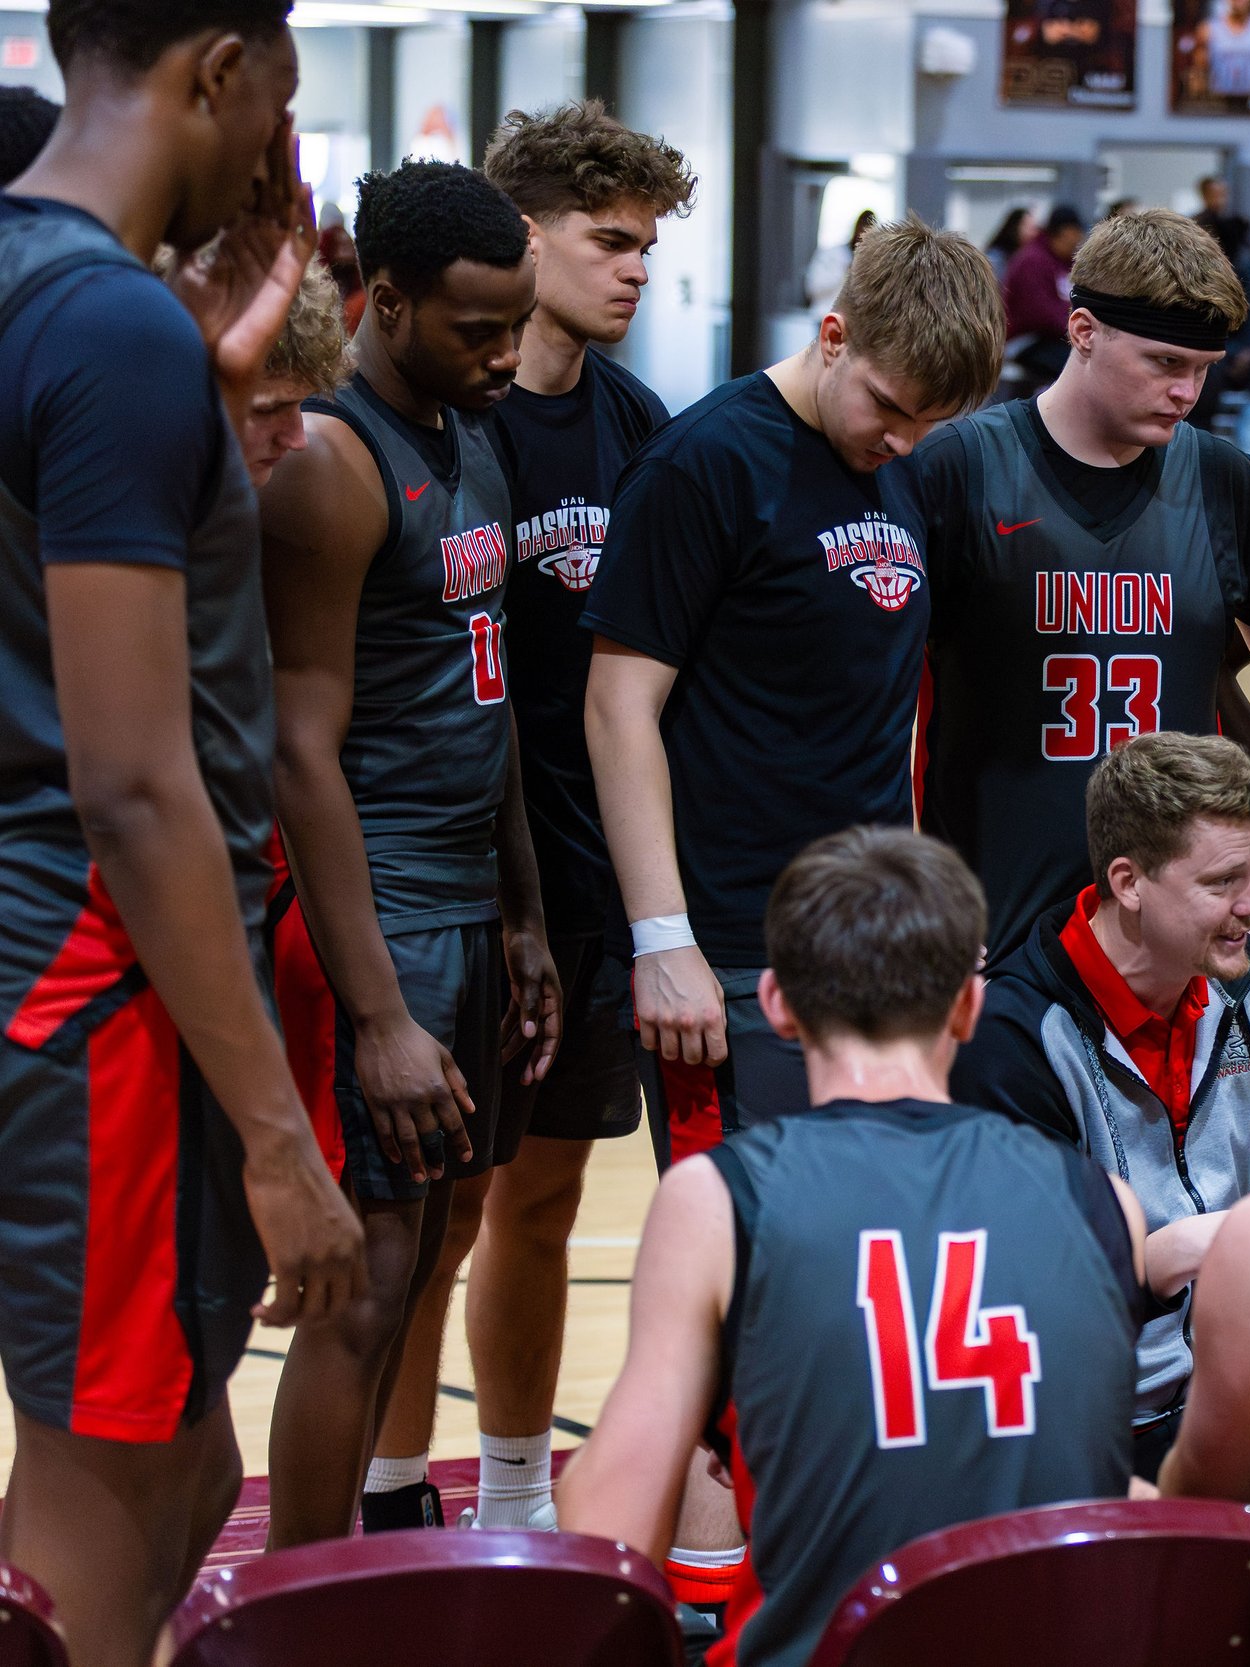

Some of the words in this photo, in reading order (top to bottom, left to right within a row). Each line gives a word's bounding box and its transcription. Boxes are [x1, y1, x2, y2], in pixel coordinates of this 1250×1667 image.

[561, 497, 585, 506] UAU
[864, 511, 887, 521] UAU
[440, 522, 507, 602] UNION
[516, 506, 610, 563] BASKETB
[817, 521, 927, 577] BASKETBALL
[1035, 571, 1173, 635] UNION
[469, 611, 506, 706] 0
[1041, 653, 1163, 761] 33
[856, 1228, 1042, 1450] 14
